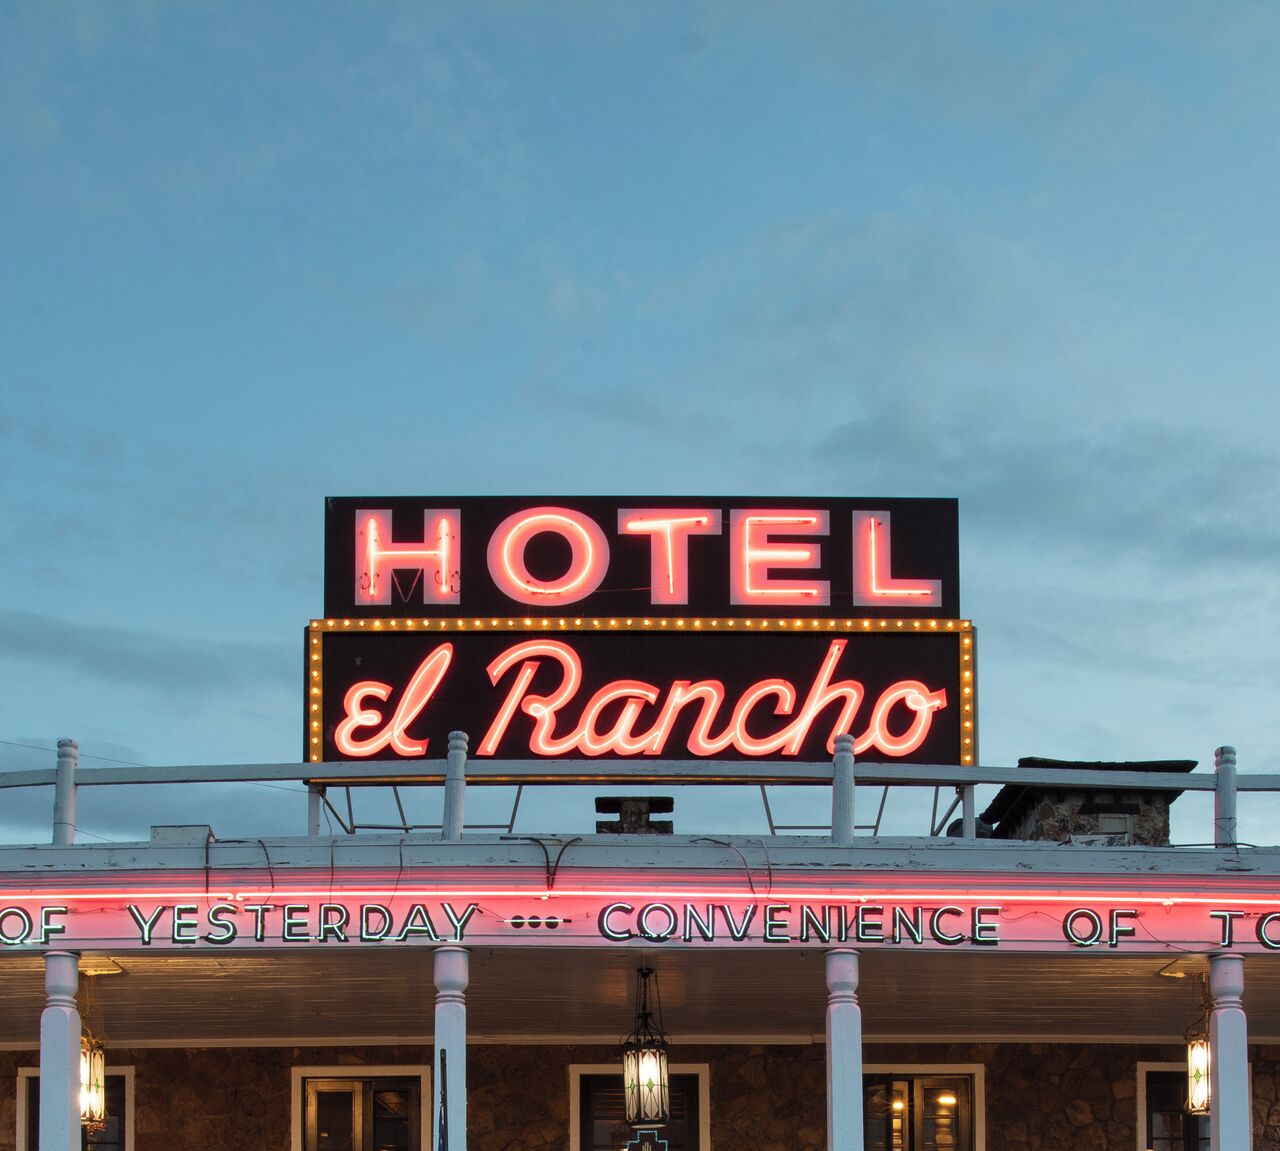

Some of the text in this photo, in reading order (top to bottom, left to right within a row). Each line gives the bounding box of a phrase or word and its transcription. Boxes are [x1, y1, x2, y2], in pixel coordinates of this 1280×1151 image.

[355, 507, 941, 606] HOTEL
[333, 638, 948, 757] El Rancho
[126, 902, 478, 945] YESTERDAY
[598, 902, 1002, 945] CONVENIENCE
[1062, 908, 1139, 948] OF
